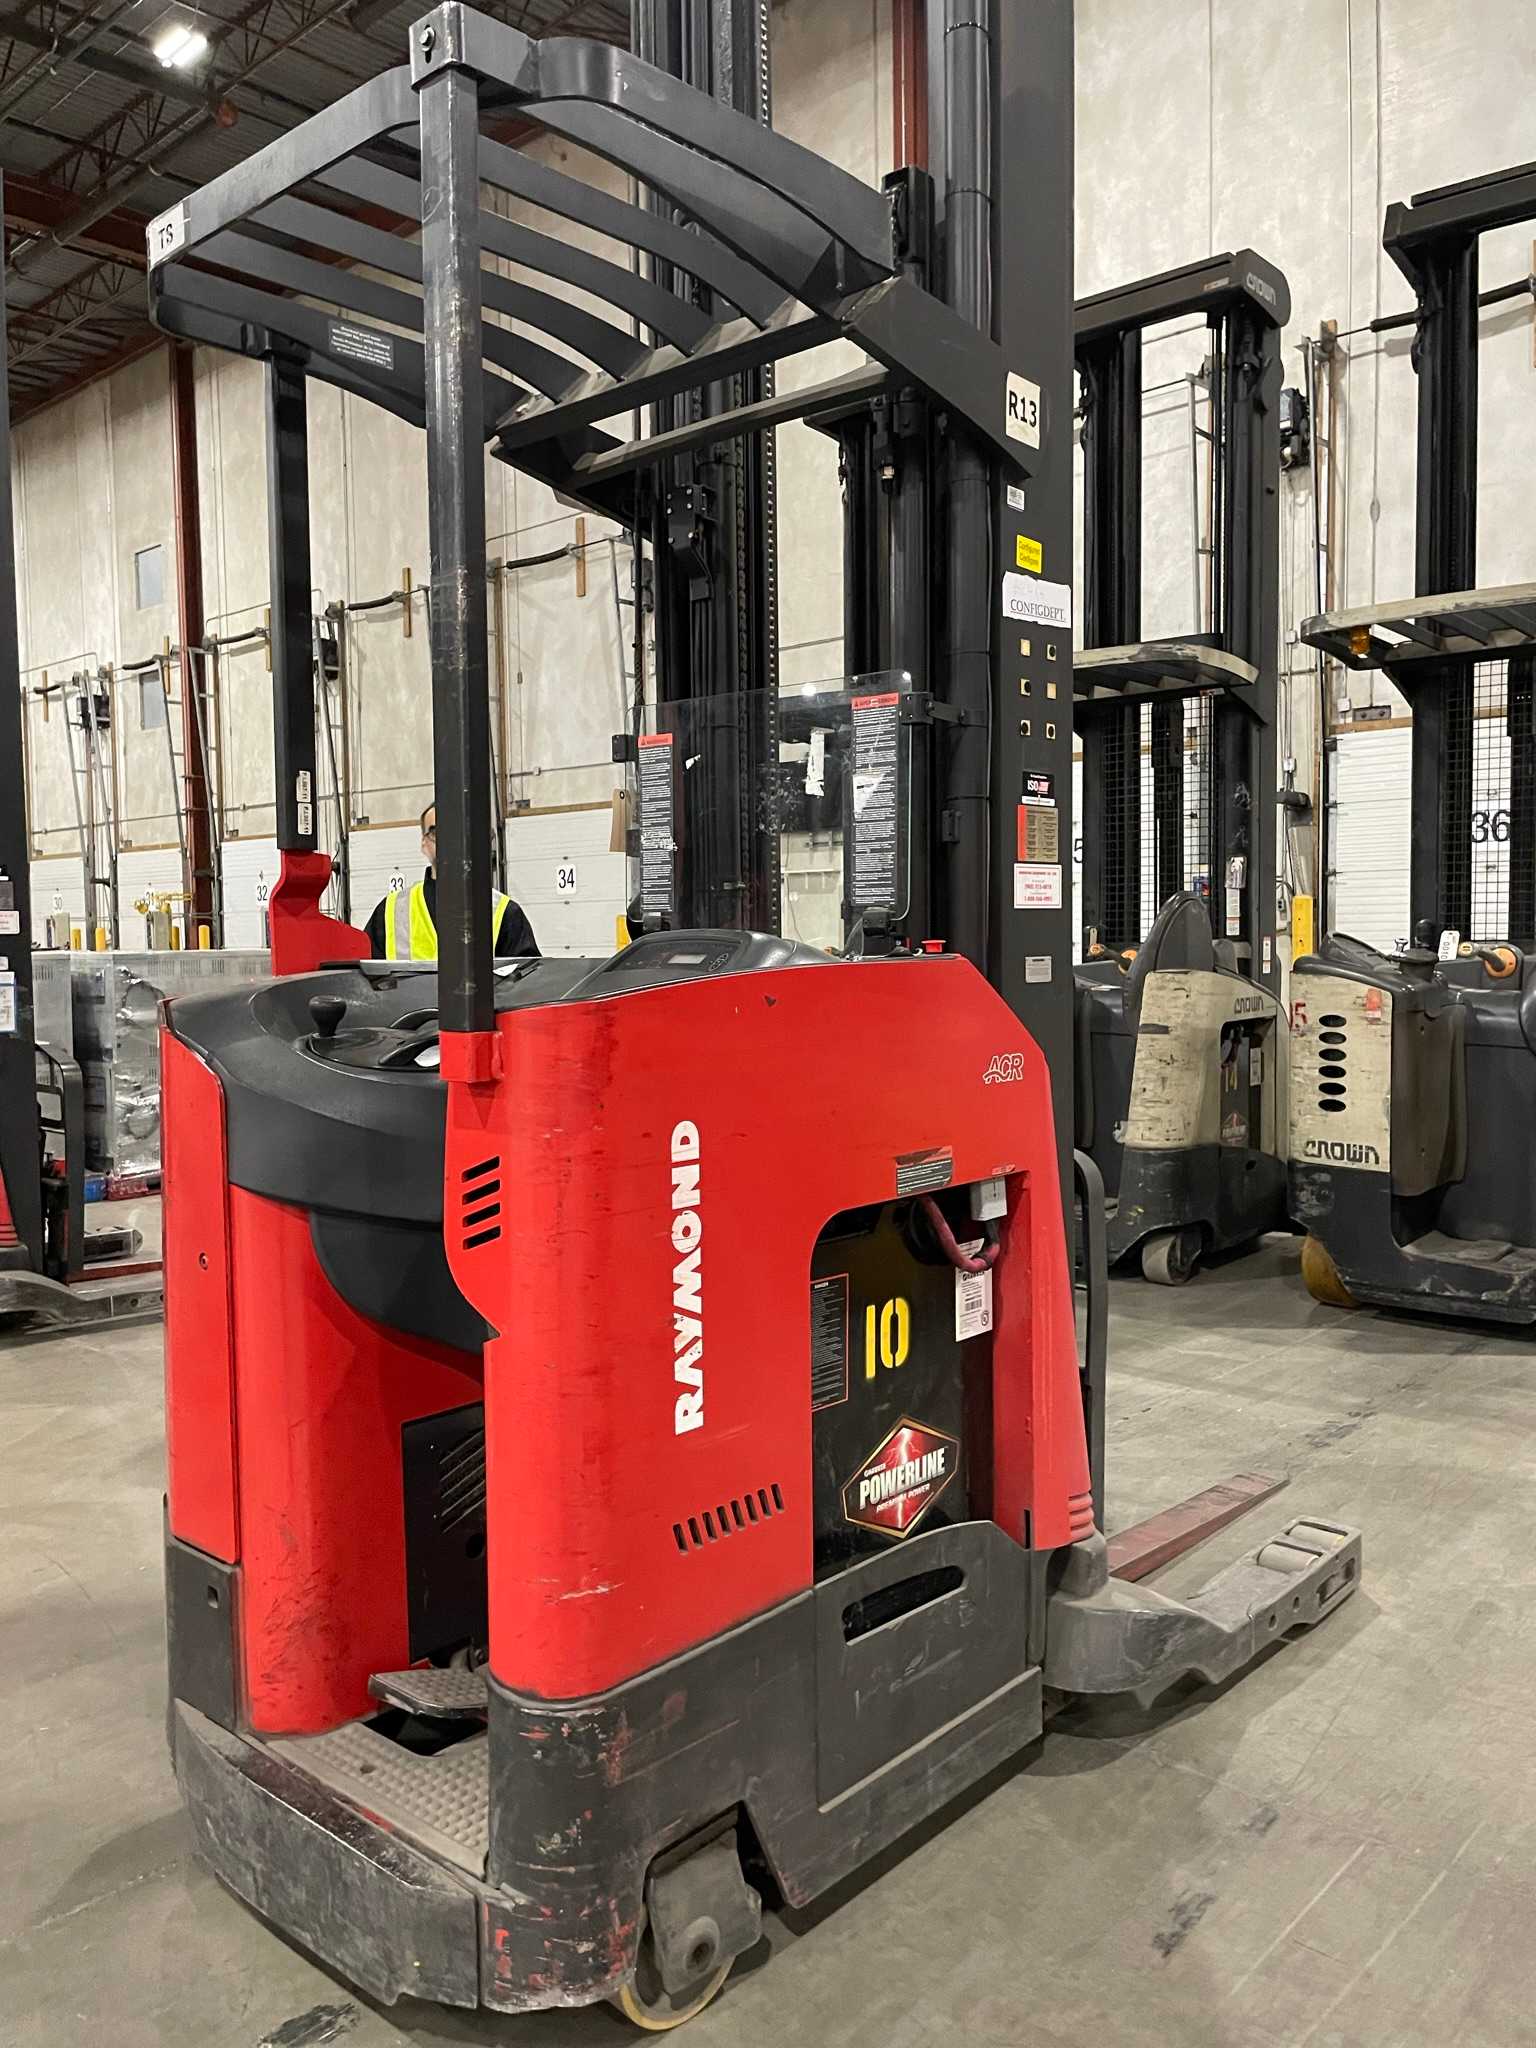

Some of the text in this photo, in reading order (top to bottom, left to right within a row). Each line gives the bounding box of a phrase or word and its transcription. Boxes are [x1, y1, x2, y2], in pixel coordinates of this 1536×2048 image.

[158, 223, 174, 250] TS
[1009, 390, 1037, 428] R13
[1471, 809, 1511, 843] 36
[256, 885, 268, 902] 32
[558, 868, 575, 889] 34
[982, 1053, 1024, 1084] ACR
[1304, 1140, 1380, 1164] CROWN
[671, 1120, 704, 1436] RAYMOND
[865, 1297, 910, 1379] 10
[859, 1447, 946, 1510] POWERLINE
[907, 1483, 931, 1499] POWER
